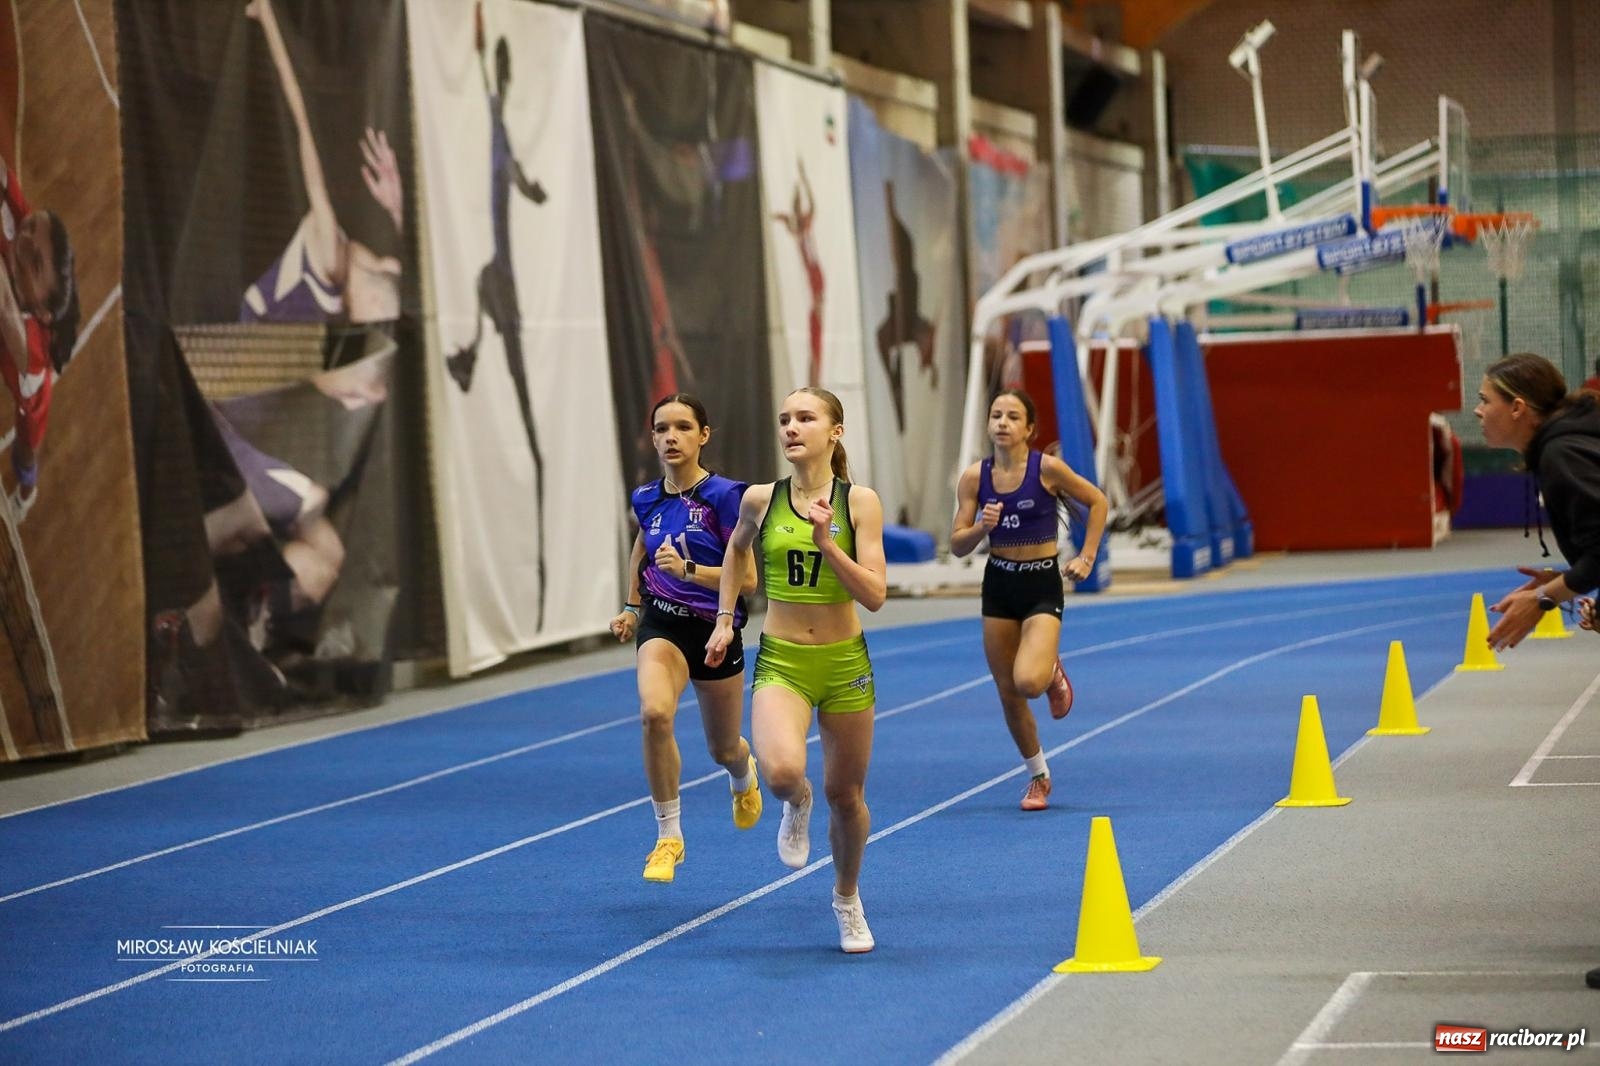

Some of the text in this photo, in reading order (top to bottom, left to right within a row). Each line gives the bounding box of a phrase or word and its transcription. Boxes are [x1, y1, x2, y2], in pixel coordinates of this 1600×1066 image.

[787, 549, 823, 587] 67
[1019, 560, 1053, 572] PRO
[653, 598, 690, 617] NIKE
